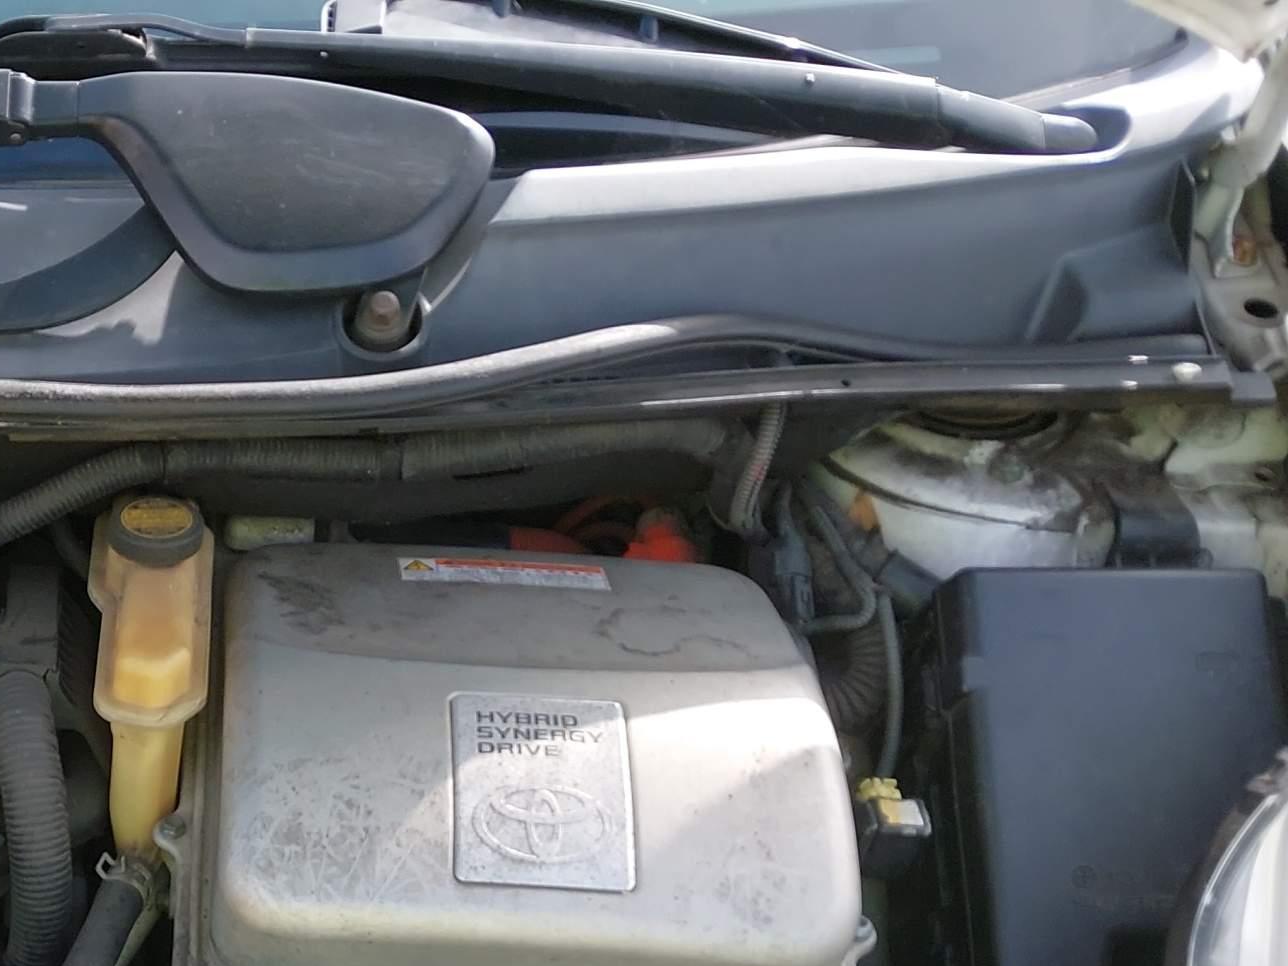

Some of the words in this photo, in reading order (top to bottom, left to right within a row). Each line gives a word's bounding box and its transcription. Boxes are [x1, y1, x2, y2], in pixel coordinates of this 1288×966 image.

[475, 711, 579, 728] HYBRID
[476, 726, 604, 744] SYNERGY
[477, 742, 561, 757] DRIVE
